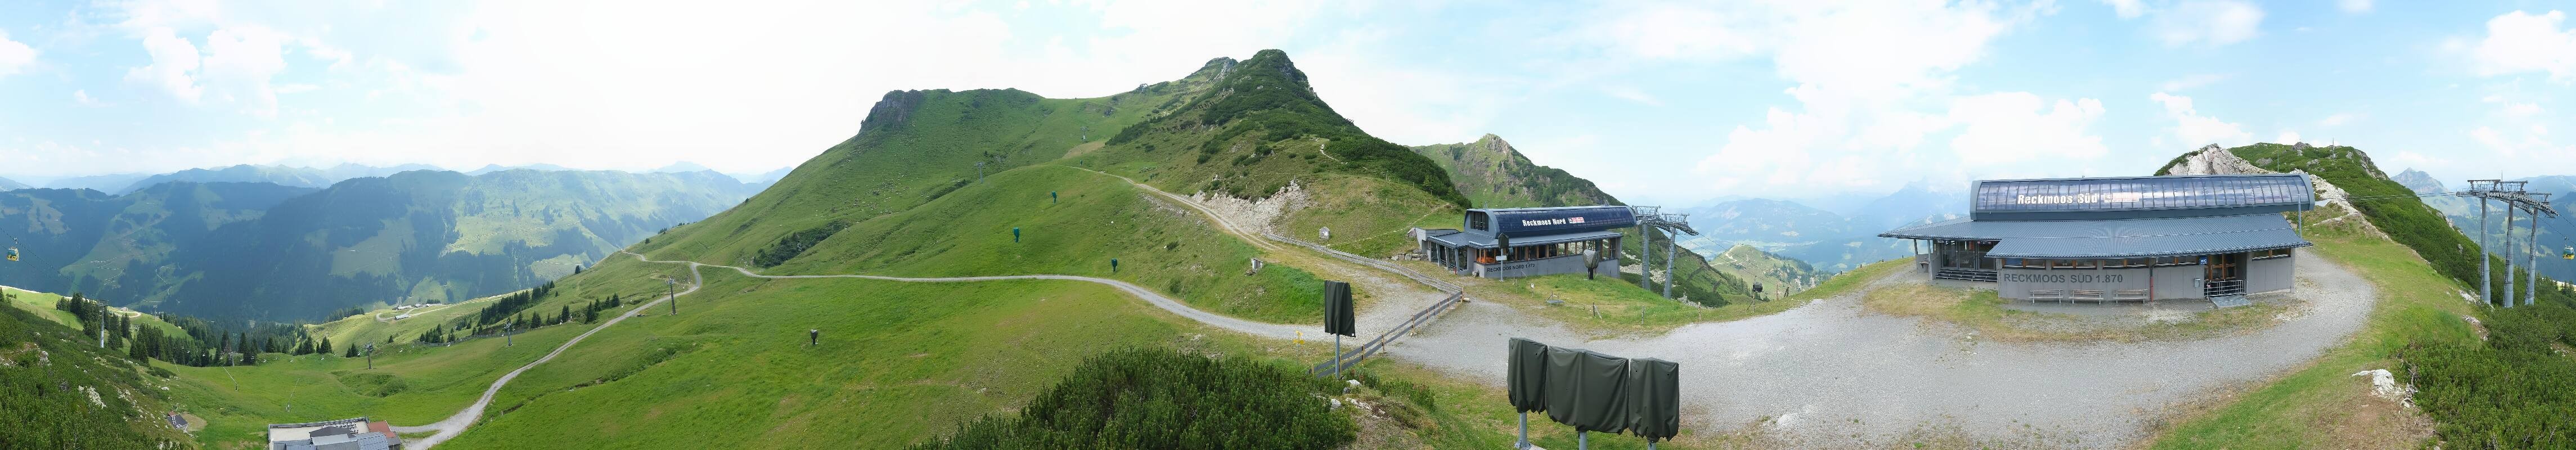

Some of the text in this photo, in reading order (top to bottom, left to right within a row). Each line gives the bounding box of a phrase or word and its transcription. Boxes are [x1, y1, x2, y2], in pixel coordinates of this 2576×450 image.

[2017, 194, 2073, 204] Reckmoos
[2078, 193, 2097, 203] Süd
[2004, 273, 2123, 283] RECKMOOS SÜD 1.870
